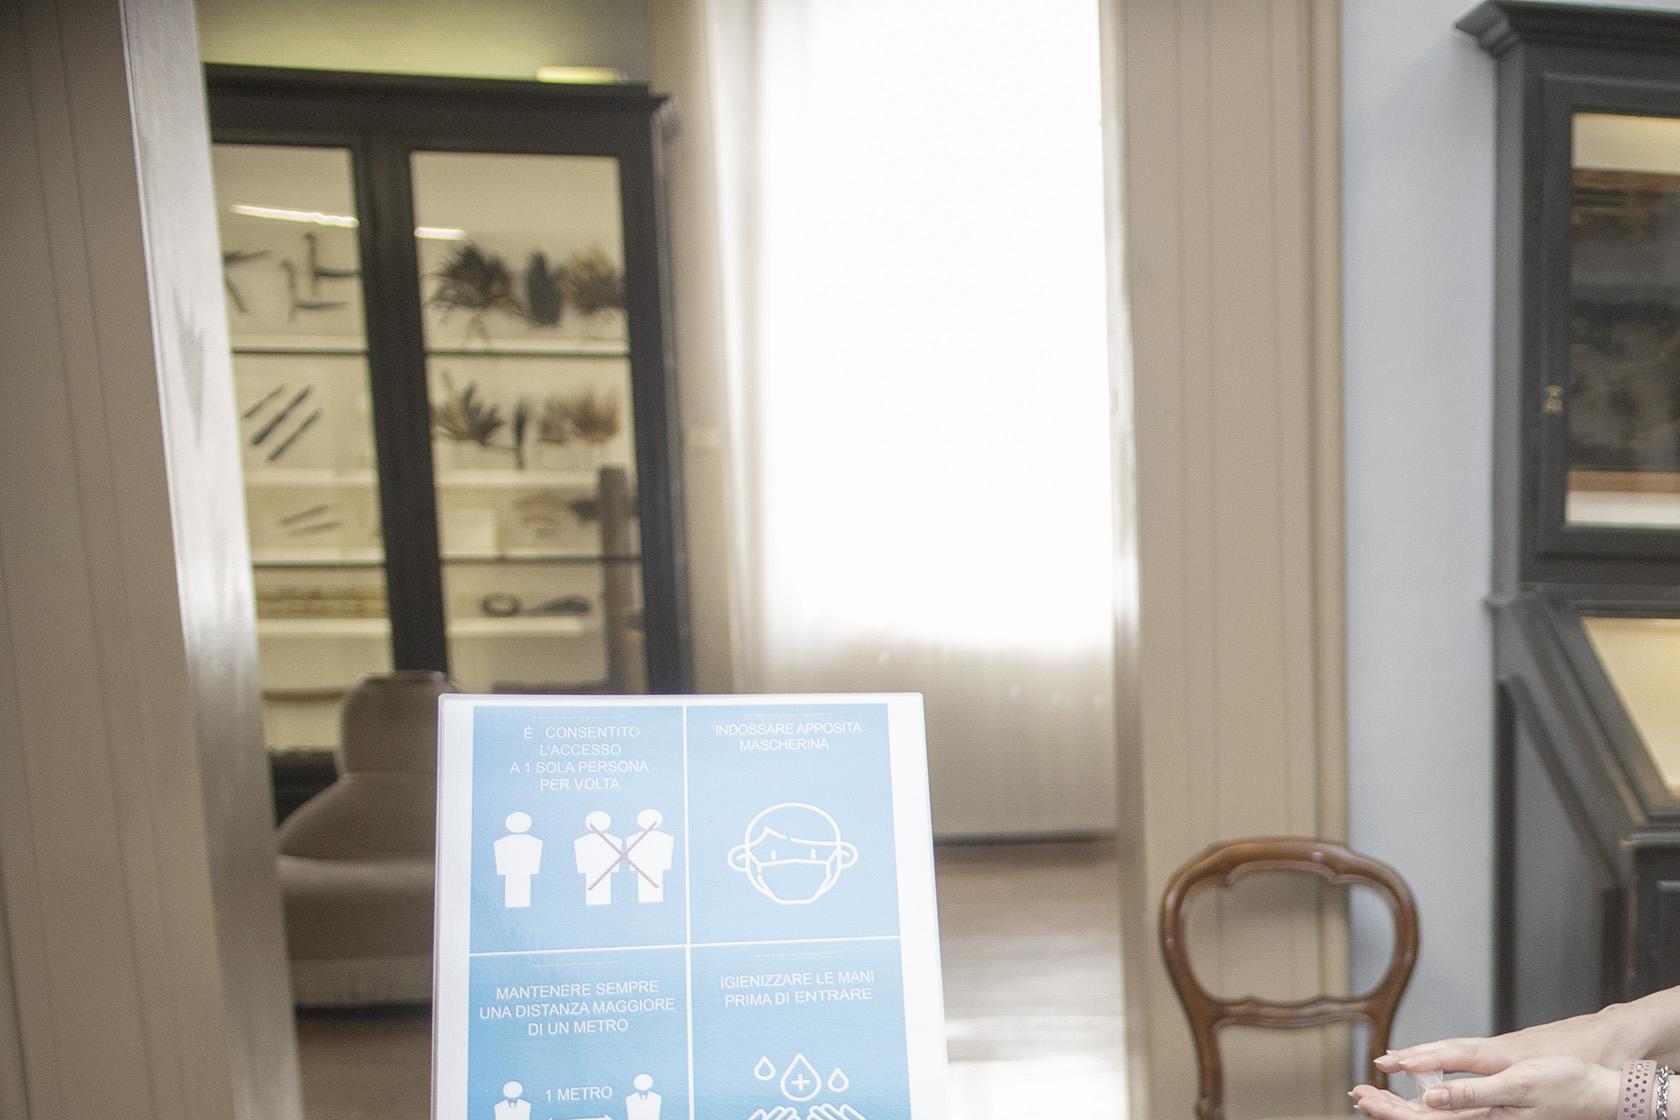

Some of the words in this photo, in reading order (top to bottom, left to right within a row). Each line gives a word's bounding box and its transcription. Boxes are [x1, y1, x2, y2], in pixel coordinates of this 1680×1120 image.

[523, 725, 534, 739] È
[545, 726, 640, 738] CONSENTITO
[715, 722, 794, 736] INDOSSARE
[796, 721, 863, 734] APPOSITA
[540, 743, 622, 756] L'ACCESSO
[739, 737, 830, 751] MASCHERINA
[510, 761, 521, 774] A
[524, 760, 531, 773] 1
[536, 761, 575, 774] SOLA
[578, 759, 649, 773] PERSONA
[540, 778, 570, 791] PER
[574, 777, 621, 791] VOLTA
[720, 972, 813, 989] IGIENIZZARE
[816, 971, 834, 984] LE
[838, 969, 874, 983] MANI
[496, 983, 592, 1000] MANTENERE
[596, 979, 660, 995] SEMPRE
[725, 993, 773, 1008] PRIMA
[775, 991, 790, 1005] DI
[795, 987, 873, 1003] ENTRARE
[479, 1005, 512, 1020] UNA
[515, 1001, 590, 1018] DISTANZA
[593, 997, 676, 1014] MAGGIORE
[528, 1022, 543, 1036] DI
[548, 1021, 569, 1035] UN
[574, 1018, 629, 1034] METRO
[545, 1089, 552, 1102] 1
[557, 1085, 613, 1101] METRO
